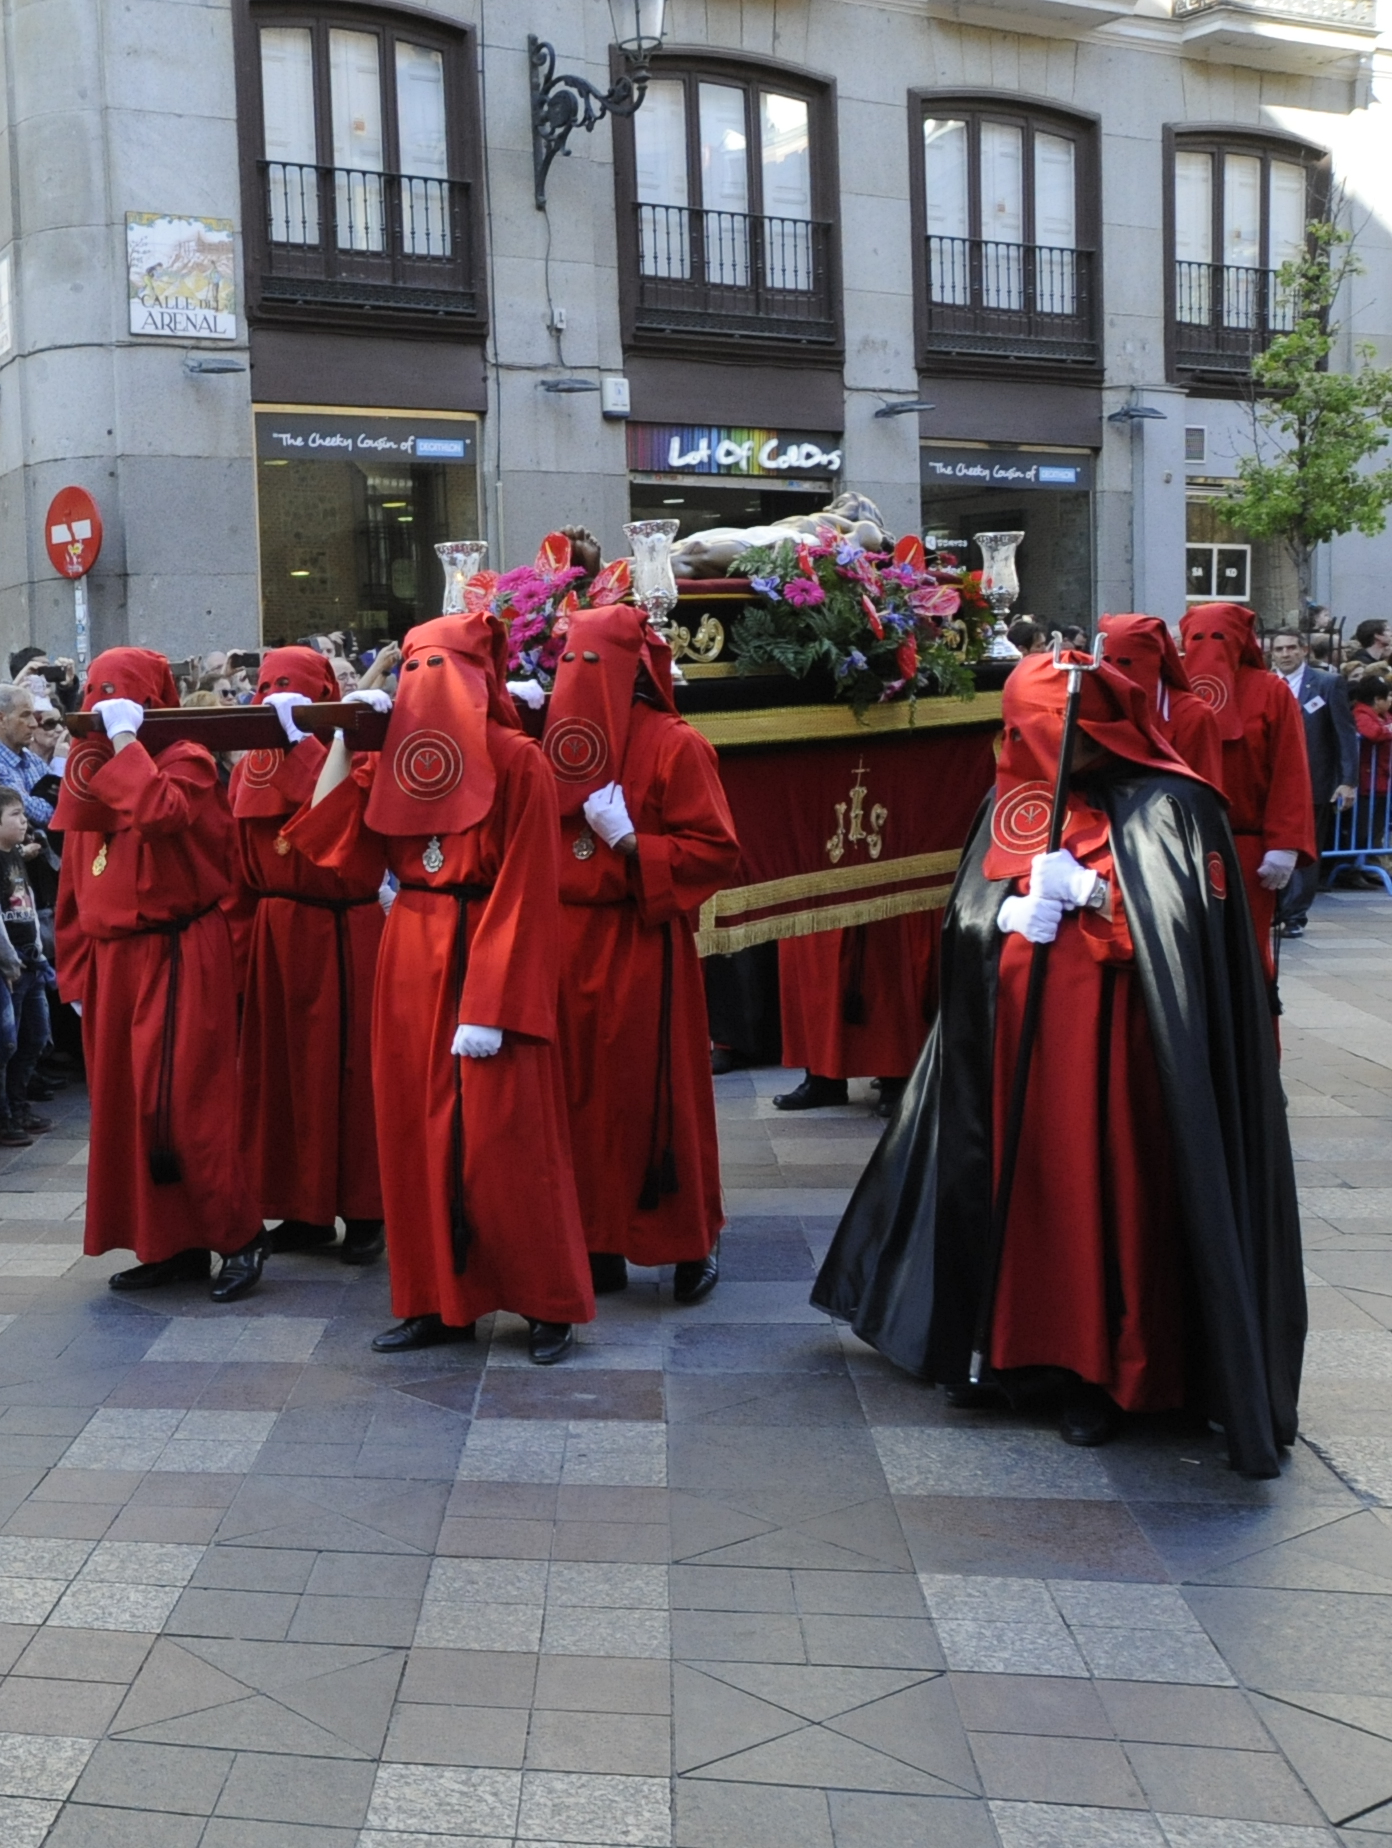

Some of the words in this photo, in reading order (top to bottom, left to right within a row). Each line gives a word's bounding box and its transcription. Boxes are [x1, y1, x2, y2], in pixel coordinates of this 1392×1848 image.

[139, 294, 196, 310] CALLE
[141, 310, 227, 335] ARENAL
[307, 432, 352, 451] Cheeky
[357, 434, 398, 450] Cousin
[400, 436, 415, 454] of
[668, 436, 711, 467] Lot
[955, 463, 990, 481] Cheeky
[993, 464, 1024, 480] Cousin
[1025, 465, 1038, 482] of
